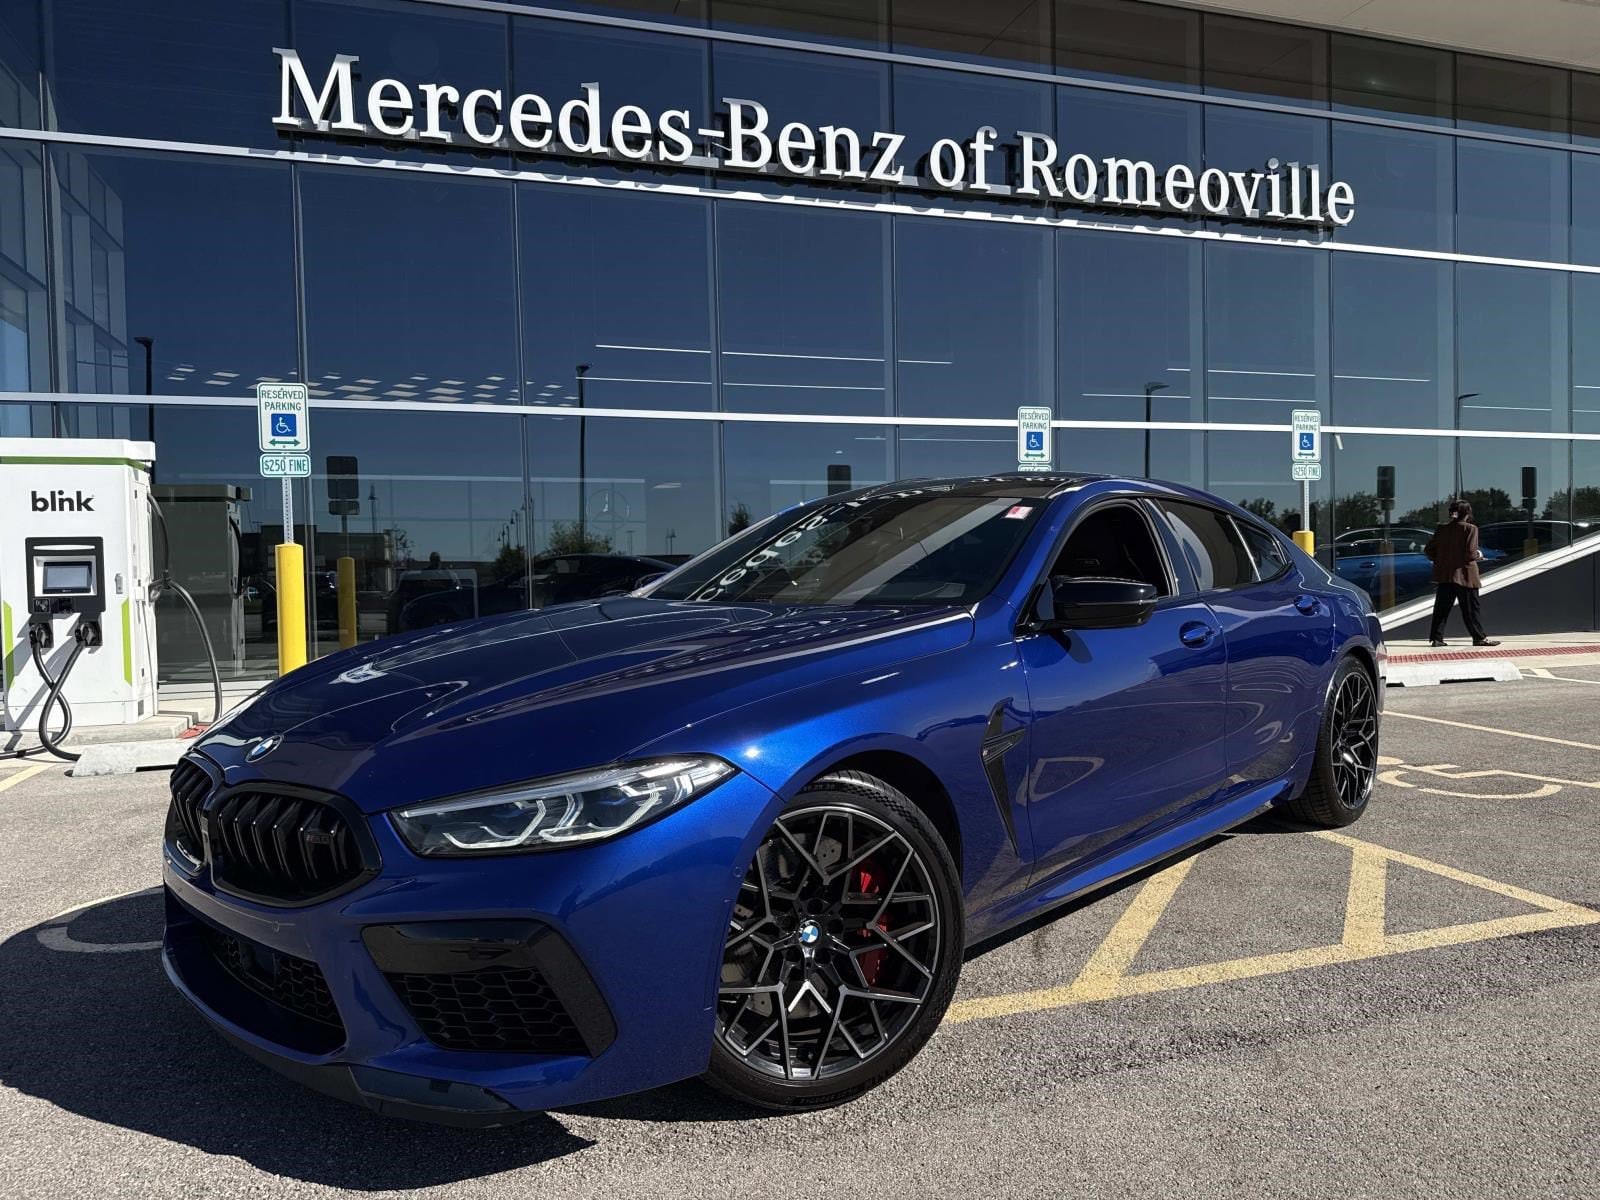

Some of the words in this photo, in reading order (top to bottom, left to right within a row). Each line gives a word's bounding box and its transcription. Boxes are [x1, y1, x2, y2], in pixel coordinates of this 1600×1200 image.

[272, 47, 905, 184] Mercedes-Benz
[928, 125, 998, 191] of
[1016, 129, 1355, 227] Romeoville
[261, 390, 304, 399] RESERVED
[264, 401, 302, 411] PARKING
[1021, 412, 1049, 420] RESERVED
[1022, 422, 1047, 430] PARKING
[264, 459, 286, 472] $250
[289, 459, 307, 472] FINE
[31, 490, 96, 512] blink
